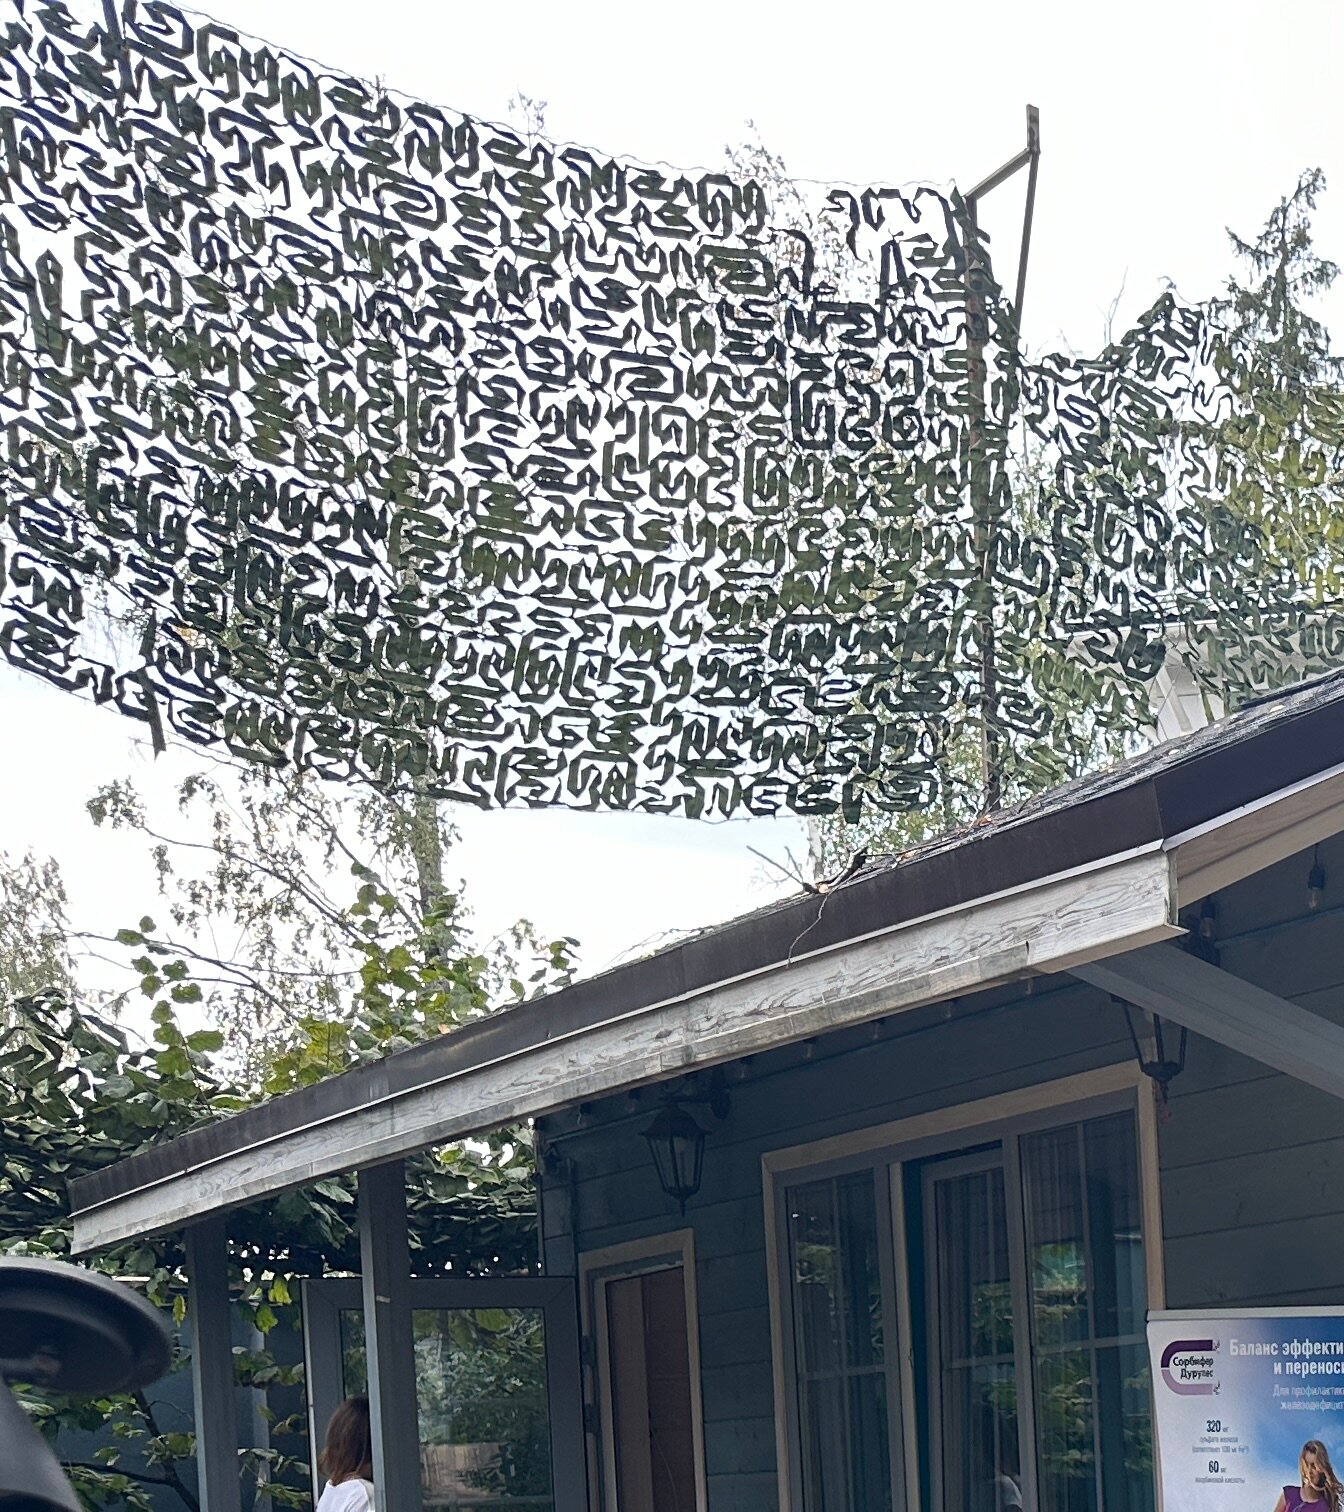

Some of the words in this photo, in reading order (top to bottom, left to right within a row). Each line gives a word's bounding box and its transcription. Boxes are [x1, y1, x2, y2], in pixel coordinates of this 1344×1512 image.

[1229, 1339, 1279, 1355] Баланс
[1172, 1356, 1214, 1367] Сорбифер
[1273, 1362, 1282, 1374] и
[1206, 1419, 1221, 1433] 320
[1208, 1460, 1220, 1473] 60
